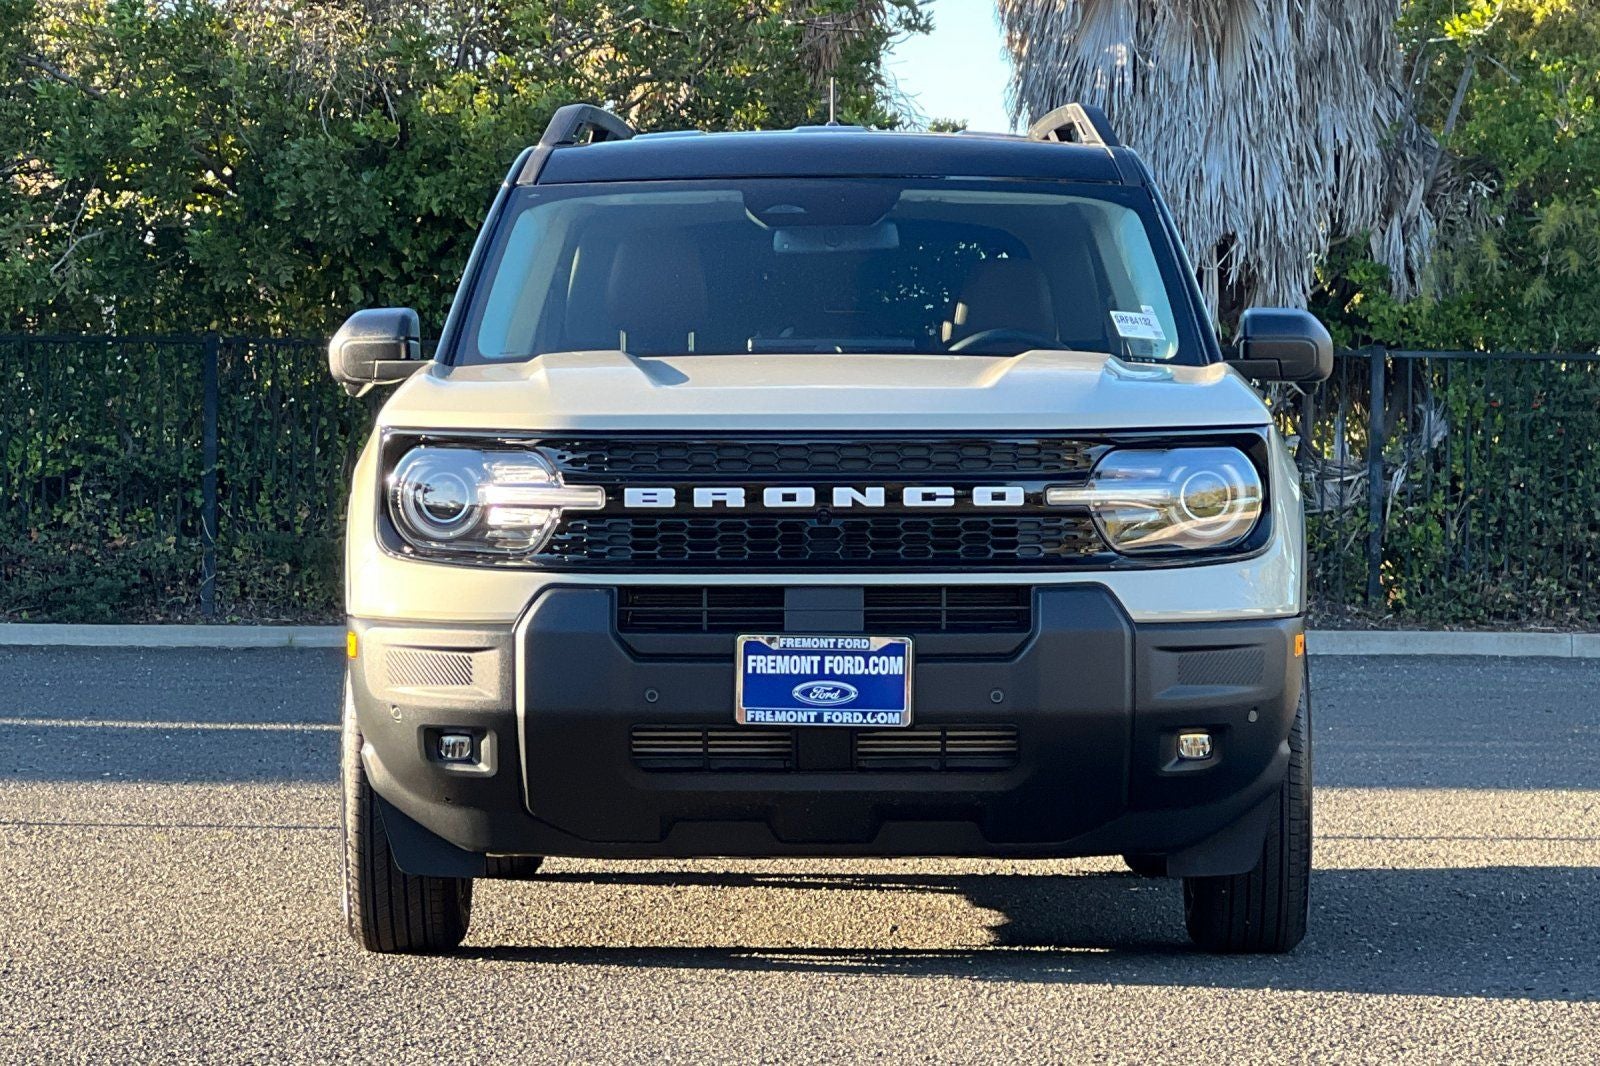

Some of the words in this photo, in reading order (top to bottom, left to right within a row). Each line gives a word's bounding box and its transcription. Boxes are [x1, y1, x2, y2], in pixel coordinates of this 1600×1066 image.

[624, 486, 1025, 508] BRONCO
[779, 637, 836, 649] FREMONT
[838, 638, 870, 650] FORD
[747, 655, 821, 675] FREMONT
[824, 655, 904, 675] FORD.COM
[809, 686, 841, 700] Ford
[746, 710, 817, 723] FREMONT
[823, 711, 900, 724] FORD.COM
